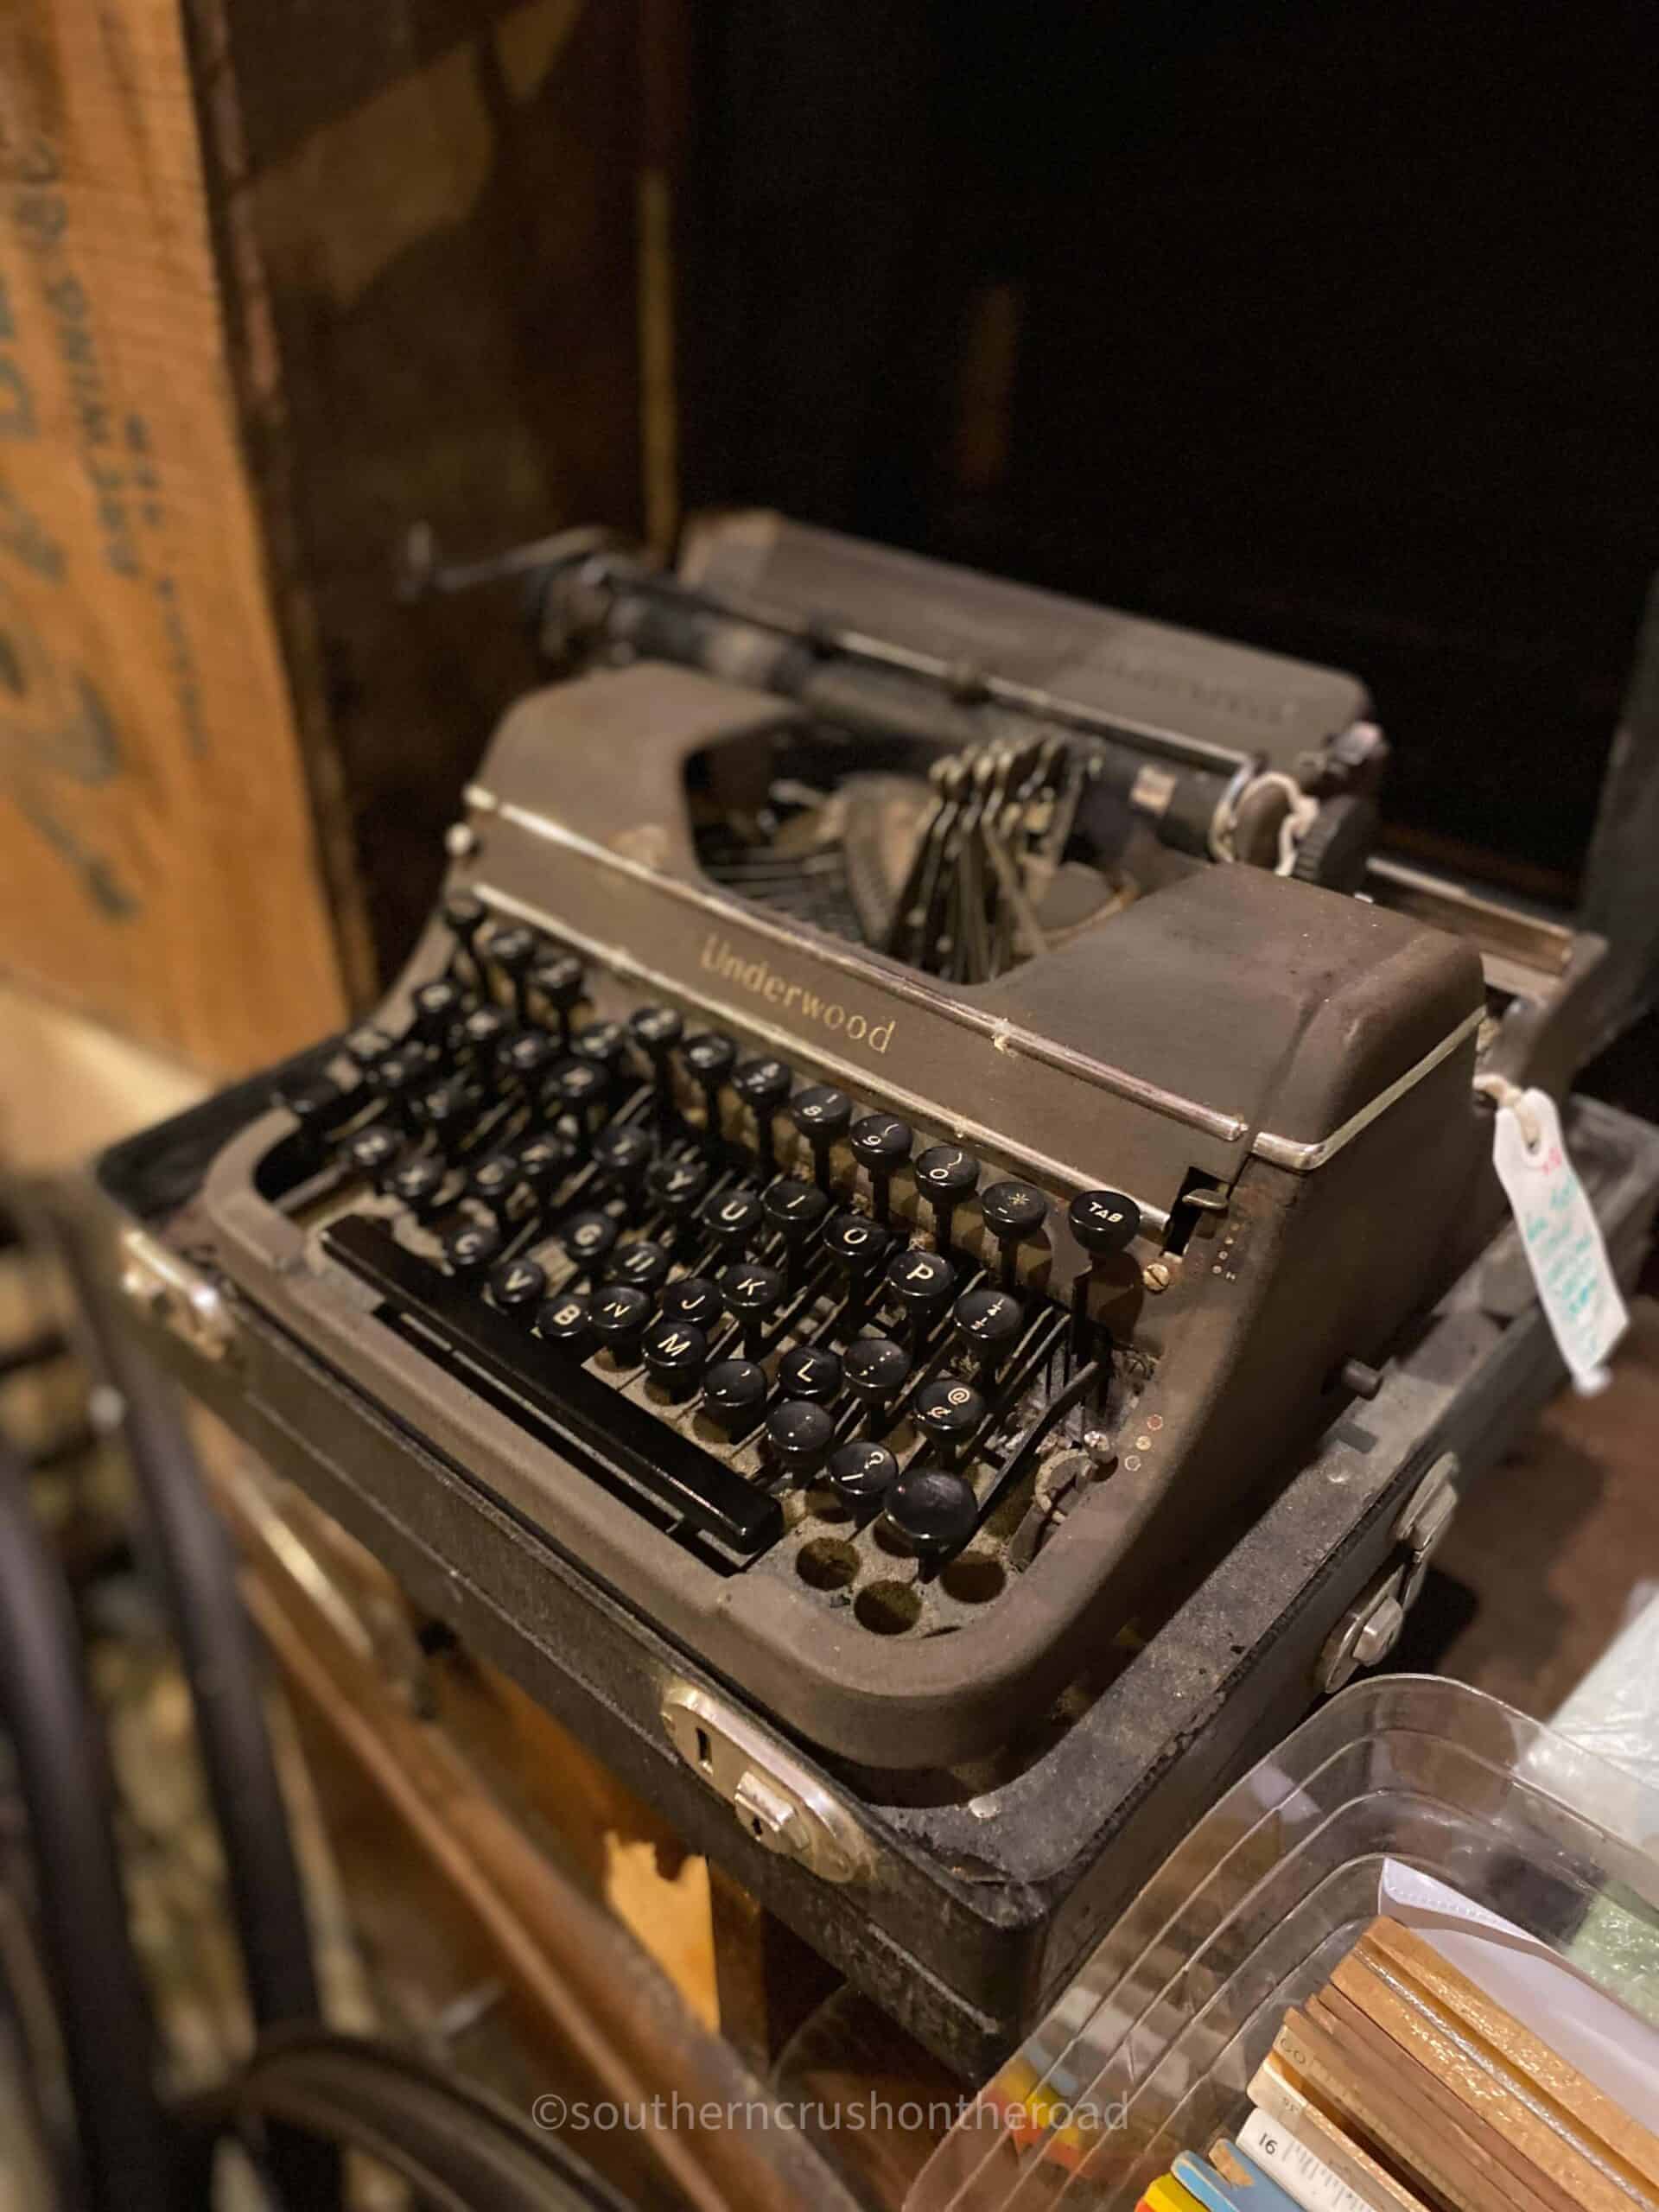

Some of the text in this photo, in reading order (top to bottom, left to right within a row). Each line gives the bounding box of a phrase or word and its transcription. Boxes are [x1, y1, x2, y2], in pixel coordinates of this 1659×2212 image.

[699, 933, 897, 1054] Underwood
[803, 1105, 823, 1116] 8
[861, 1135, 882, 1146] 9
[721, 1200, 749, 1221] U
[1089, 1201, 1124, 1224] TAB
[505, 1268, 533, 1291] V
[906, 1262, 935, 1281] P
[737, 1278, 767, 1296] K
[602, 1301, 632, 1319] N
[681, 1295, 706, 1311] J
[552, 1303, 581, 1326] B
[657, 1332, 692, 1357] M
[797, 1358, 817, 1382] L
[947, 1387, 971, 1406] @
[863, 1452, 885, 1470] ?
[1258, 2133, 1278, 2155] 16
